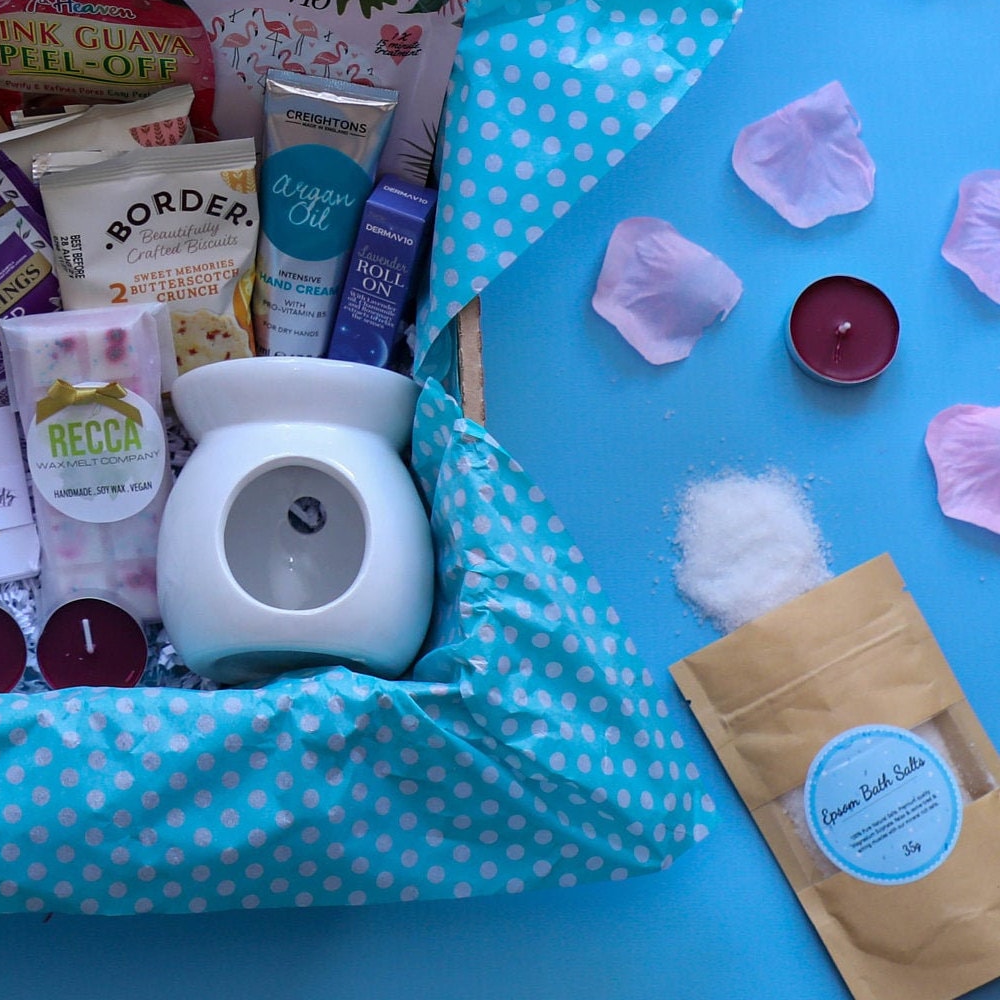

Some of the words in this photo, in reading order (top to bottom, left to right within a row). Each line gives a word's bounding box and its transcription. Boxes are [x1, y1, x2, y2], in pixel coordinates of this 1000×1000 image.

[73, 24, 195, 58] GUAVA
[286, 109, 368, 134] CREIGHTONS
[383, 184, 429, 206] DERMAV10
[288, 201, 331, 231] Oil
[60, 236, 69, 248] 28
[70, 234, 81, 251] BEST
[139, 221, 220, 244] Beautifully
[365, 223, 414, 247] DERMAV10
[126, 243, 183, 265] Crafted
[185, 233, 239, 254] Biscuits
[357, 245, 409, 274] Lavender
[72, 251, 86, 280] BEFORE
[134, 270, 172, 283] SWEET
[175, 258, 235, 277] MEMORIES
[278, 268, 322, 284] INTENSIVE
[355, 258, 405, 289] ROLL
[108, 282, 129, 304] 2
[130, 267, 241, 296] BUTTERSCOTCH
[156, 283, 220, 304] CRUNCH
[259, 271, 293, 291] HAND
[295, 284, 337, 297] CREAM
[361, 277, 393, 298] ON
[262, 299, 315, 319] PRO-VITAMIN
[284, 299, 306, 309] WITH
[263, 320, 277, 331] FOR
[278, 326, 293, 335] DRY
[293, 330, 319, 338] HANDS
[47, 416, 143, 459] RECCA
[36, 461, 68, 471] WAX
[66, 458, 100, 469] MELT
[100, 449, 161, 465] COMPANY
[96, 485, 110, 496] SOY
[111, 484, 127, 494] WAX
[128, 480, 153, 493] VEGAN
[821, 797, 861, 827] Epsom
[859, 772, 893, 802] Bath
[892, 755, 926, 780] Salts
[902, 840, 922, 857] 35g
